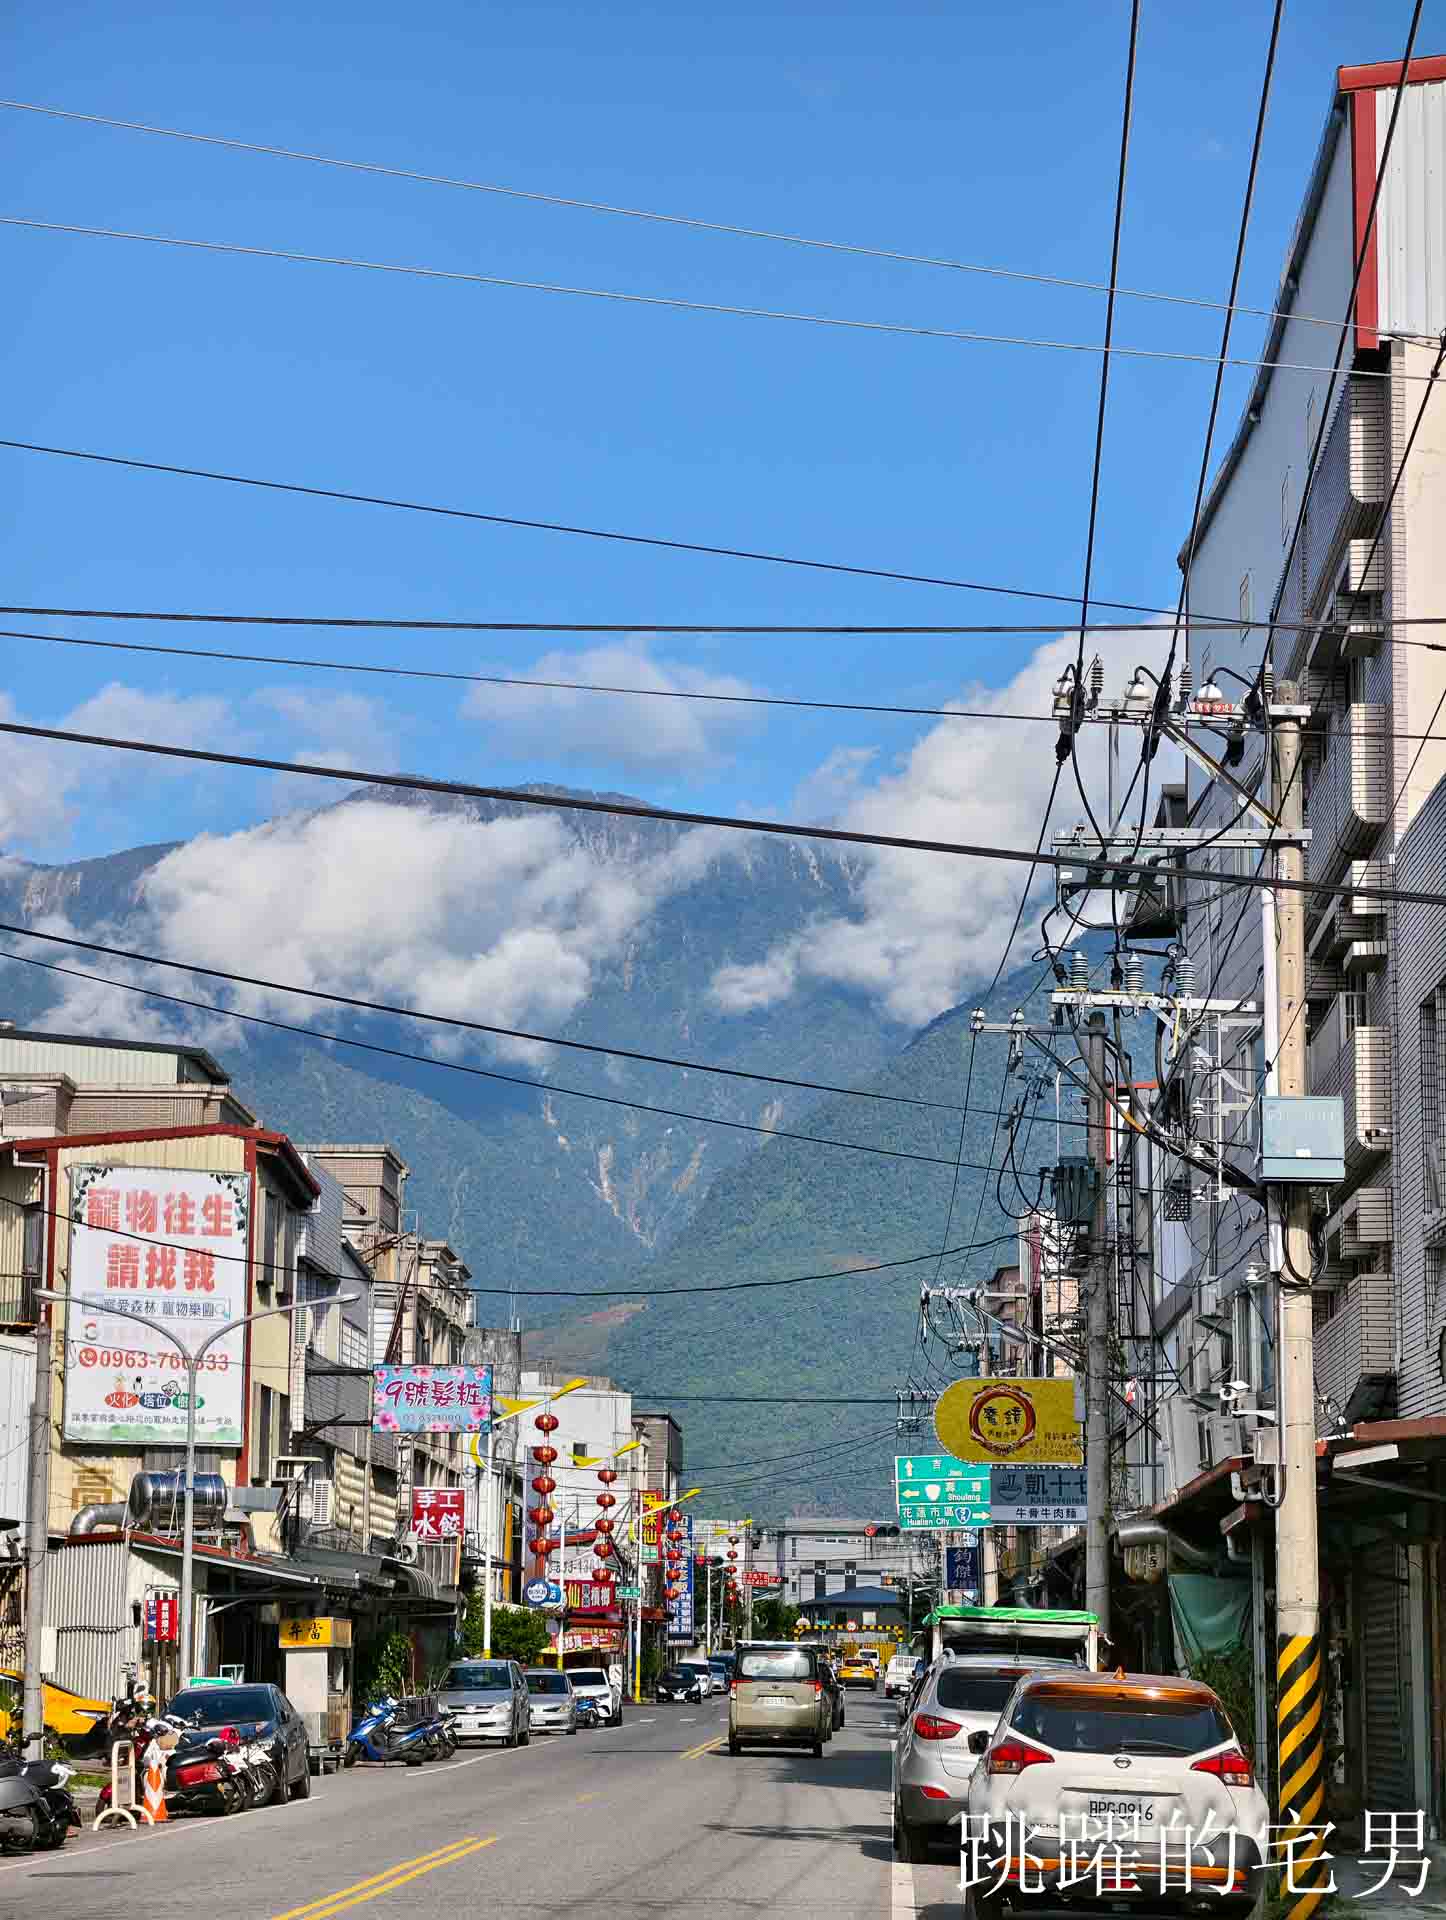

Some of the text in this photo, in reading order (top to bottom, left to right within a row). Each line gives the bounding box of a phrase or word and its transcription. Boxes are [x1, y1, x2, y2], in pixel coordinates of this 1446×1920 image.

[88, 1187, 233, 1237] 寵物往生
[107, 1244, 215, 1292] 請找我
[110, 1394, 133, 1409] 火化
[144, 1393, 167, 1408] 塔位
[385, 1380, 481, 1407] 9號髮粧
[417, 1491, 459, 1508] 手工
[903, 1506, 954, 1518] 花蓮市區
[936, 1517, 950, 1526] City
[414, 1511, 460, 1536] 水餃
